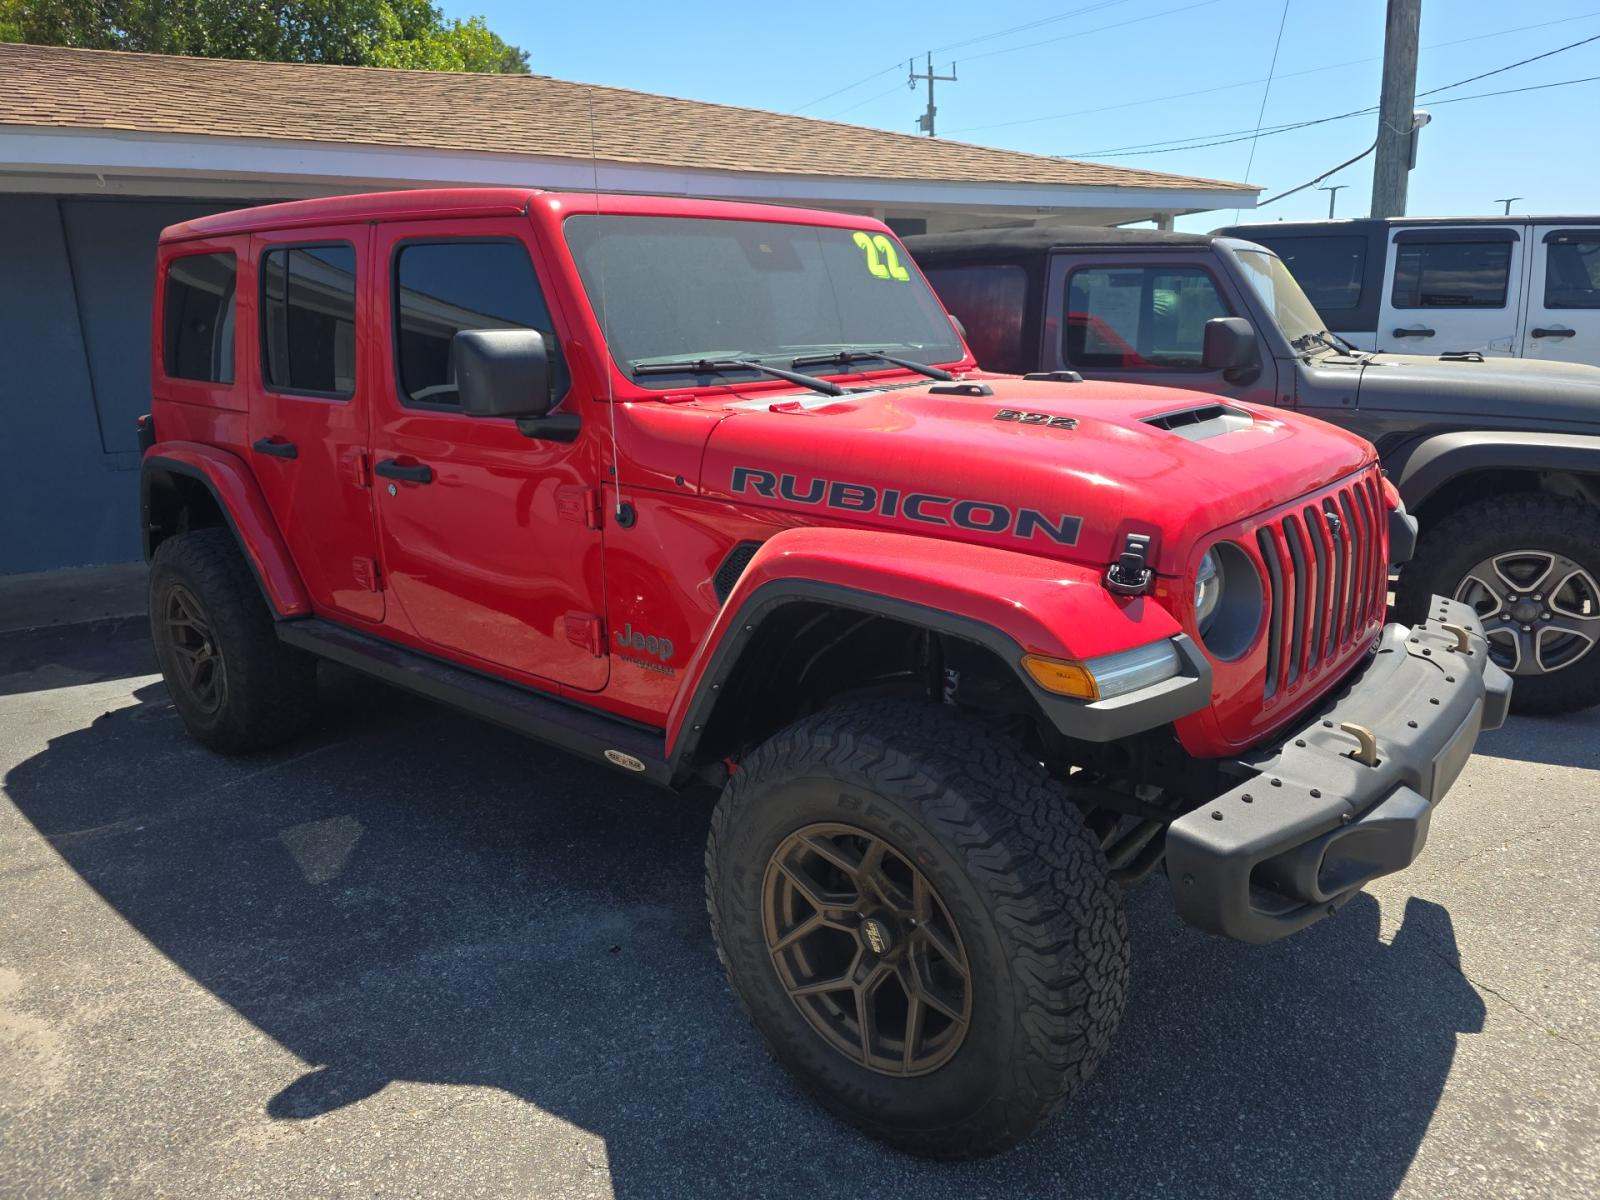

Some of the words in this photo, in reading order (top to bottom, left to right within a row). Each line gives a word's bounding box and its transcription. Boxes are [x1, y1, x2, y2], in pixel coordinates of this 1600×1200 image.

[852, 231, 910, 281] 22
[730, 466, 1083, 547] RUBICON
[613, 623, 674, 661] Jeep
